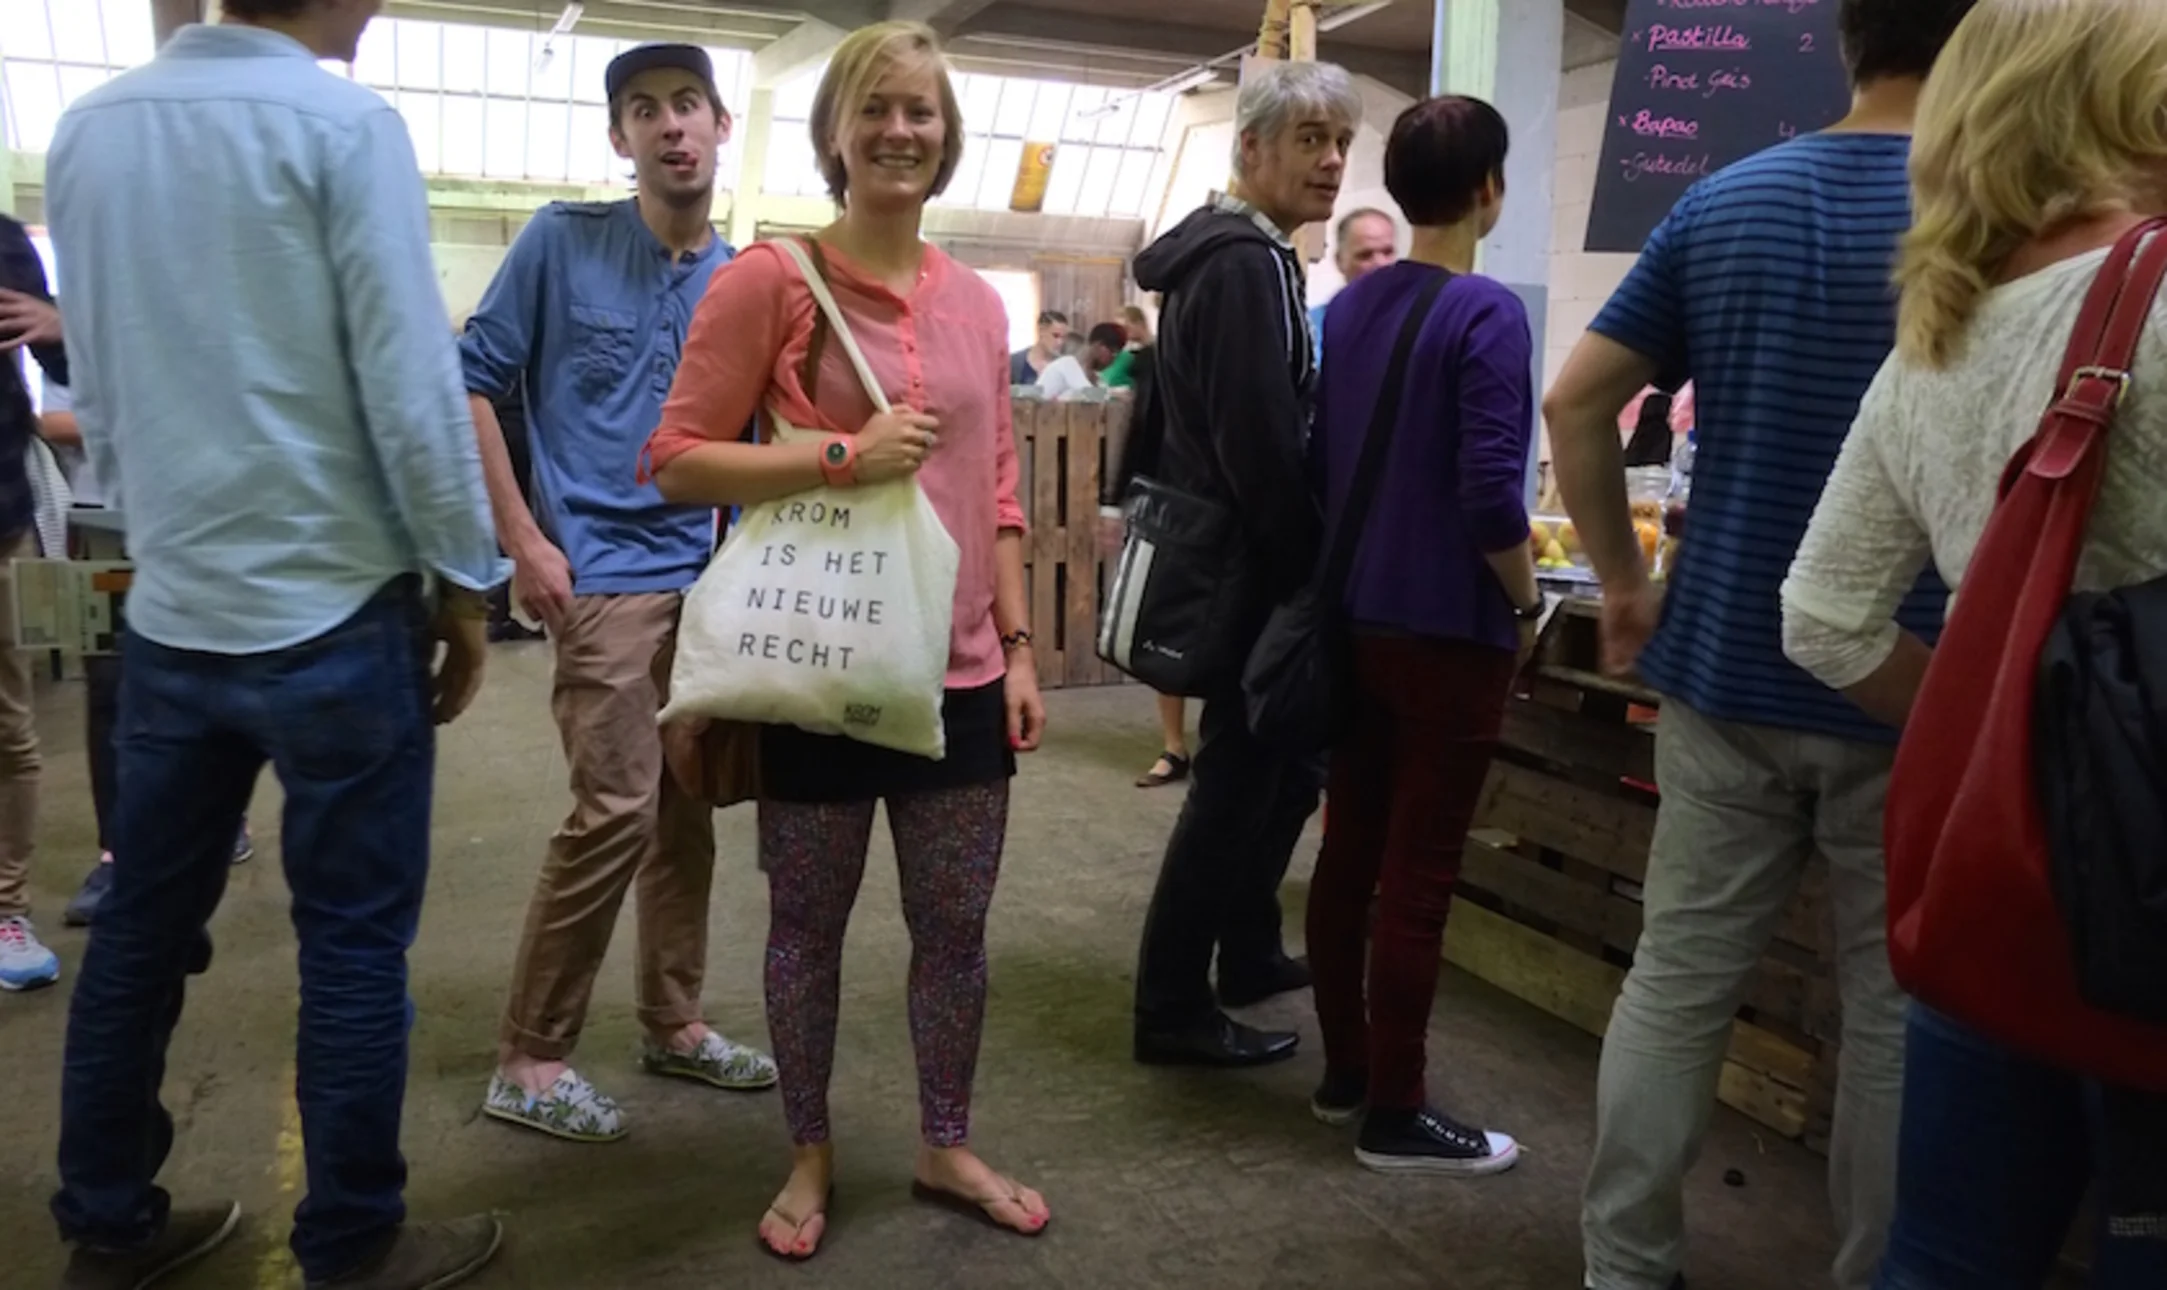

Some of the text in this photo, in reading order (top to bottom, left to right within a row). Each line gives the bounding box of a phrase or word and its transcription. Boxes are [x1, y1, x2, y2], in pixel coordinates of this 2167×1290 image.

[1649, 24, 1750, 51] Pastilla
[1799, 33, 1815, 52] 2
[1650, 64, 1698, 89] Pinot
[1632, 109, 1698, 138] Bapao
[770, 501, 851, 529] KROM
[760, 543, 889, 575] IS HET
[746, 587, 884, 625] NIEUWE
[738, 632, 855, 670] RECHT
